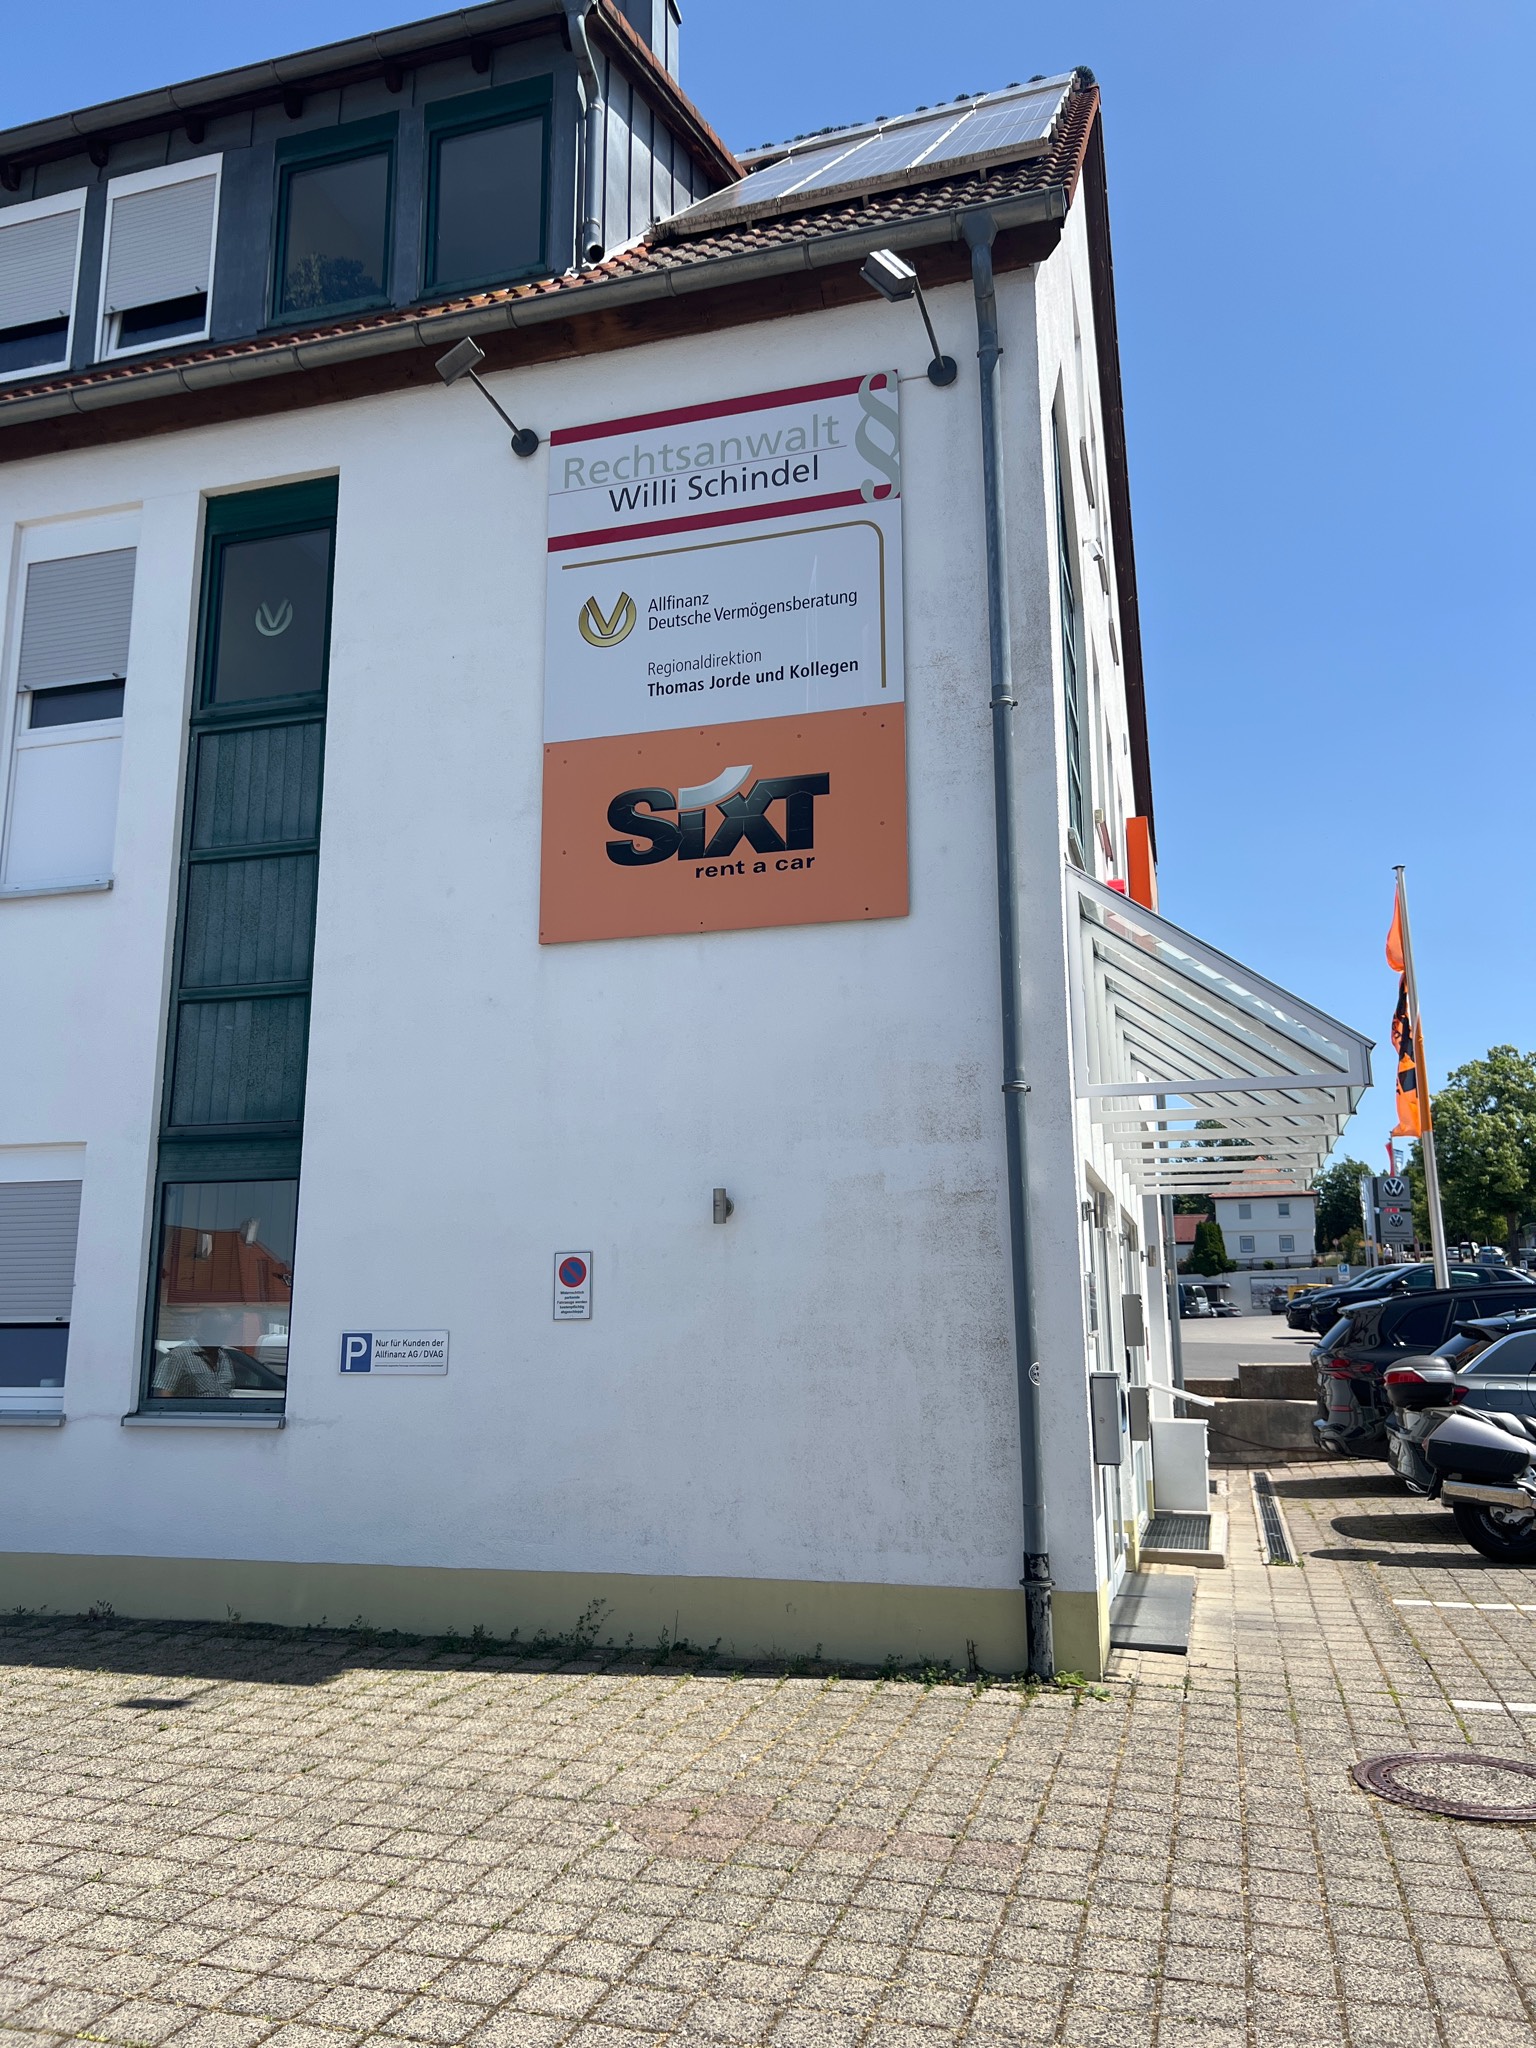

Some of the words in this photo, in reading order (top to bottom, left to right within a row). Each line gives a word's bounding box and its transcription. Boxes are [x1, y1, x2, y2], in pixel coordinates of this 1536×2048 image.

[563, 413, 840, 489] Rechtsanwalt
[609, 478, 676, 512] Willi
[688, 455, 818, 500] Schindel
[648, 592, 709, 612] Allfinanz
[648, 609, 711, 631] Deutsche
[714, 589, 857, 622] Vermögensberatung
[647, 649, 762, 677] Regionaldirektion
[647, 678, 705, 697] Thomas
[709, 671, 750, 690] Jorde
[755, 665, 784, 684] und
[789, 658, 859, 679] Kollegen
[695, 859, 745, 878] rent
[753, 861, 767, 873] a
[775, 856, 815, 871] car
[345, 1336, 368, 1370] P
[375, 1339, 389, 1347] Nur
[390, 1338, 401, 1347] für
[402, 1338, 430, 1347] Kunden
[431, 1338, 444, 1347] der
[375, 1350, 406, 1358] Allfinanz
